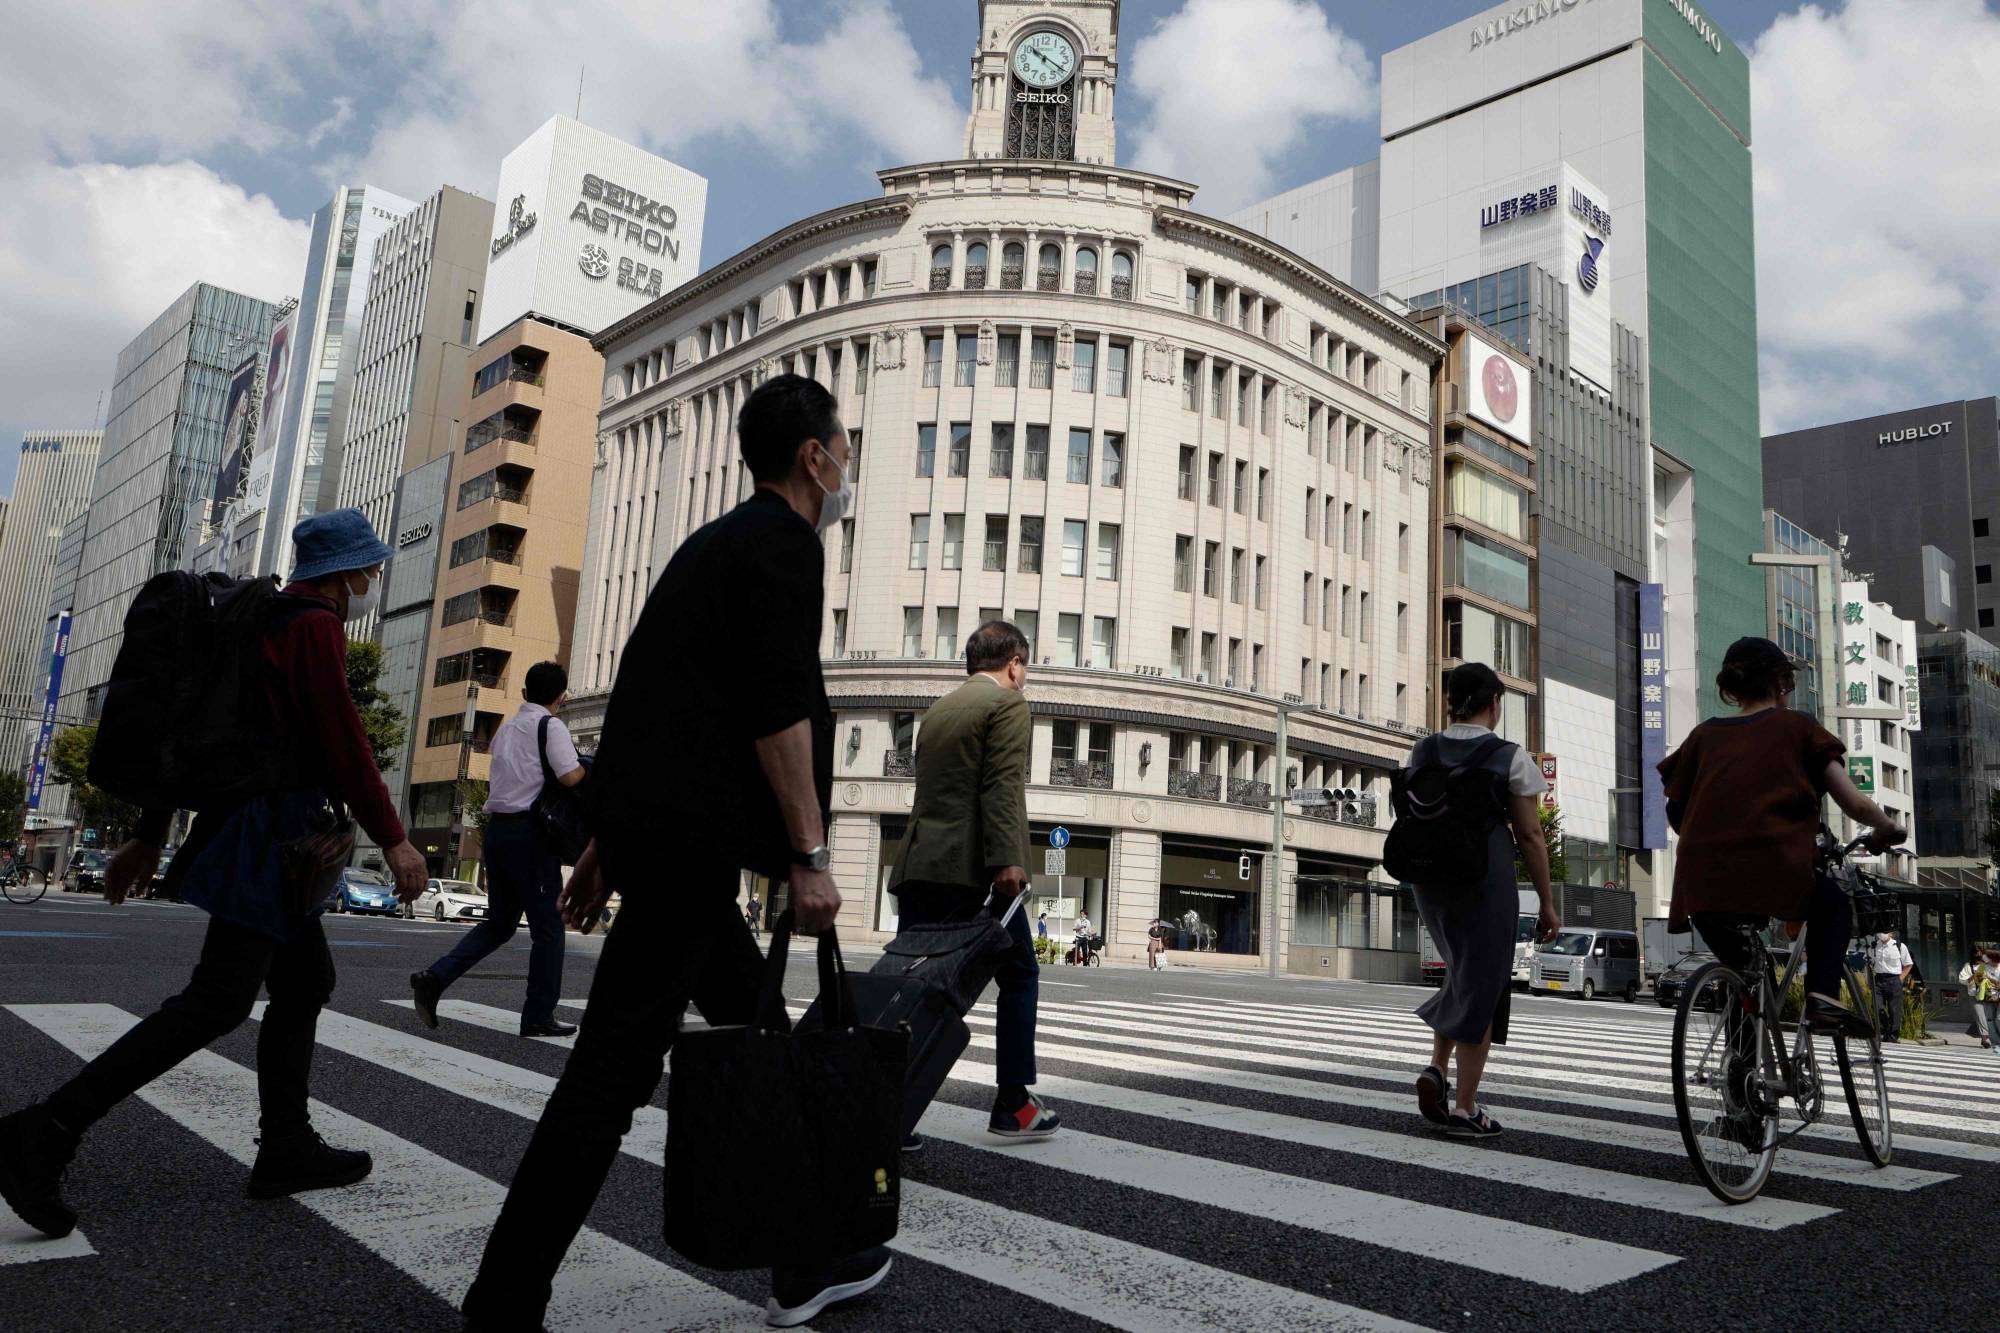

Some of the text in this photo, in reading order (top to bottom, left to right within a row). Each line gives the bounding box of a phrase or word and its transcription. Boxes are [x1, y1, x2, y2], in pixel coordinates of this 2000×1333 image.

[1033, 38, 1040, 47] 11
[1041, 36, 1050, 46] 12
[1024, 45, 1033, 54] 10
[1060, 46, 1066, 55] 2
[1020, 54, 1027, 63] 9
[1062, 56, 1069, 65] 3
[1023, 63, 1030, 72] 8
[1031, 70, 1039, 79] 7
[1049, 71, 1056, 79] 5
[1040, 73, 1047, 82] 6
[1016, 93, 1068, 104] SEIKO
[581, 173, 678, 230] SEIKO
[1481, 184, 1558, 229] 山野楽器
[372, 206, 399, 222] TENS
[1572, 185, 1612, 236] 山野楽器
[569, 200, 680, 262] ASTRON
[617, 256, 664, 286] GPS
[616, 273, 662, 298] SOLAR
[1878, 421, 1953, 446] HUBLOT
[249, 472, 270, 498] FRED
[399, 521, 432, 547] SEIKO
[1843, 601, 1867, 706] 教文館
[1642, 631, 1663, 729] 山野楽器
